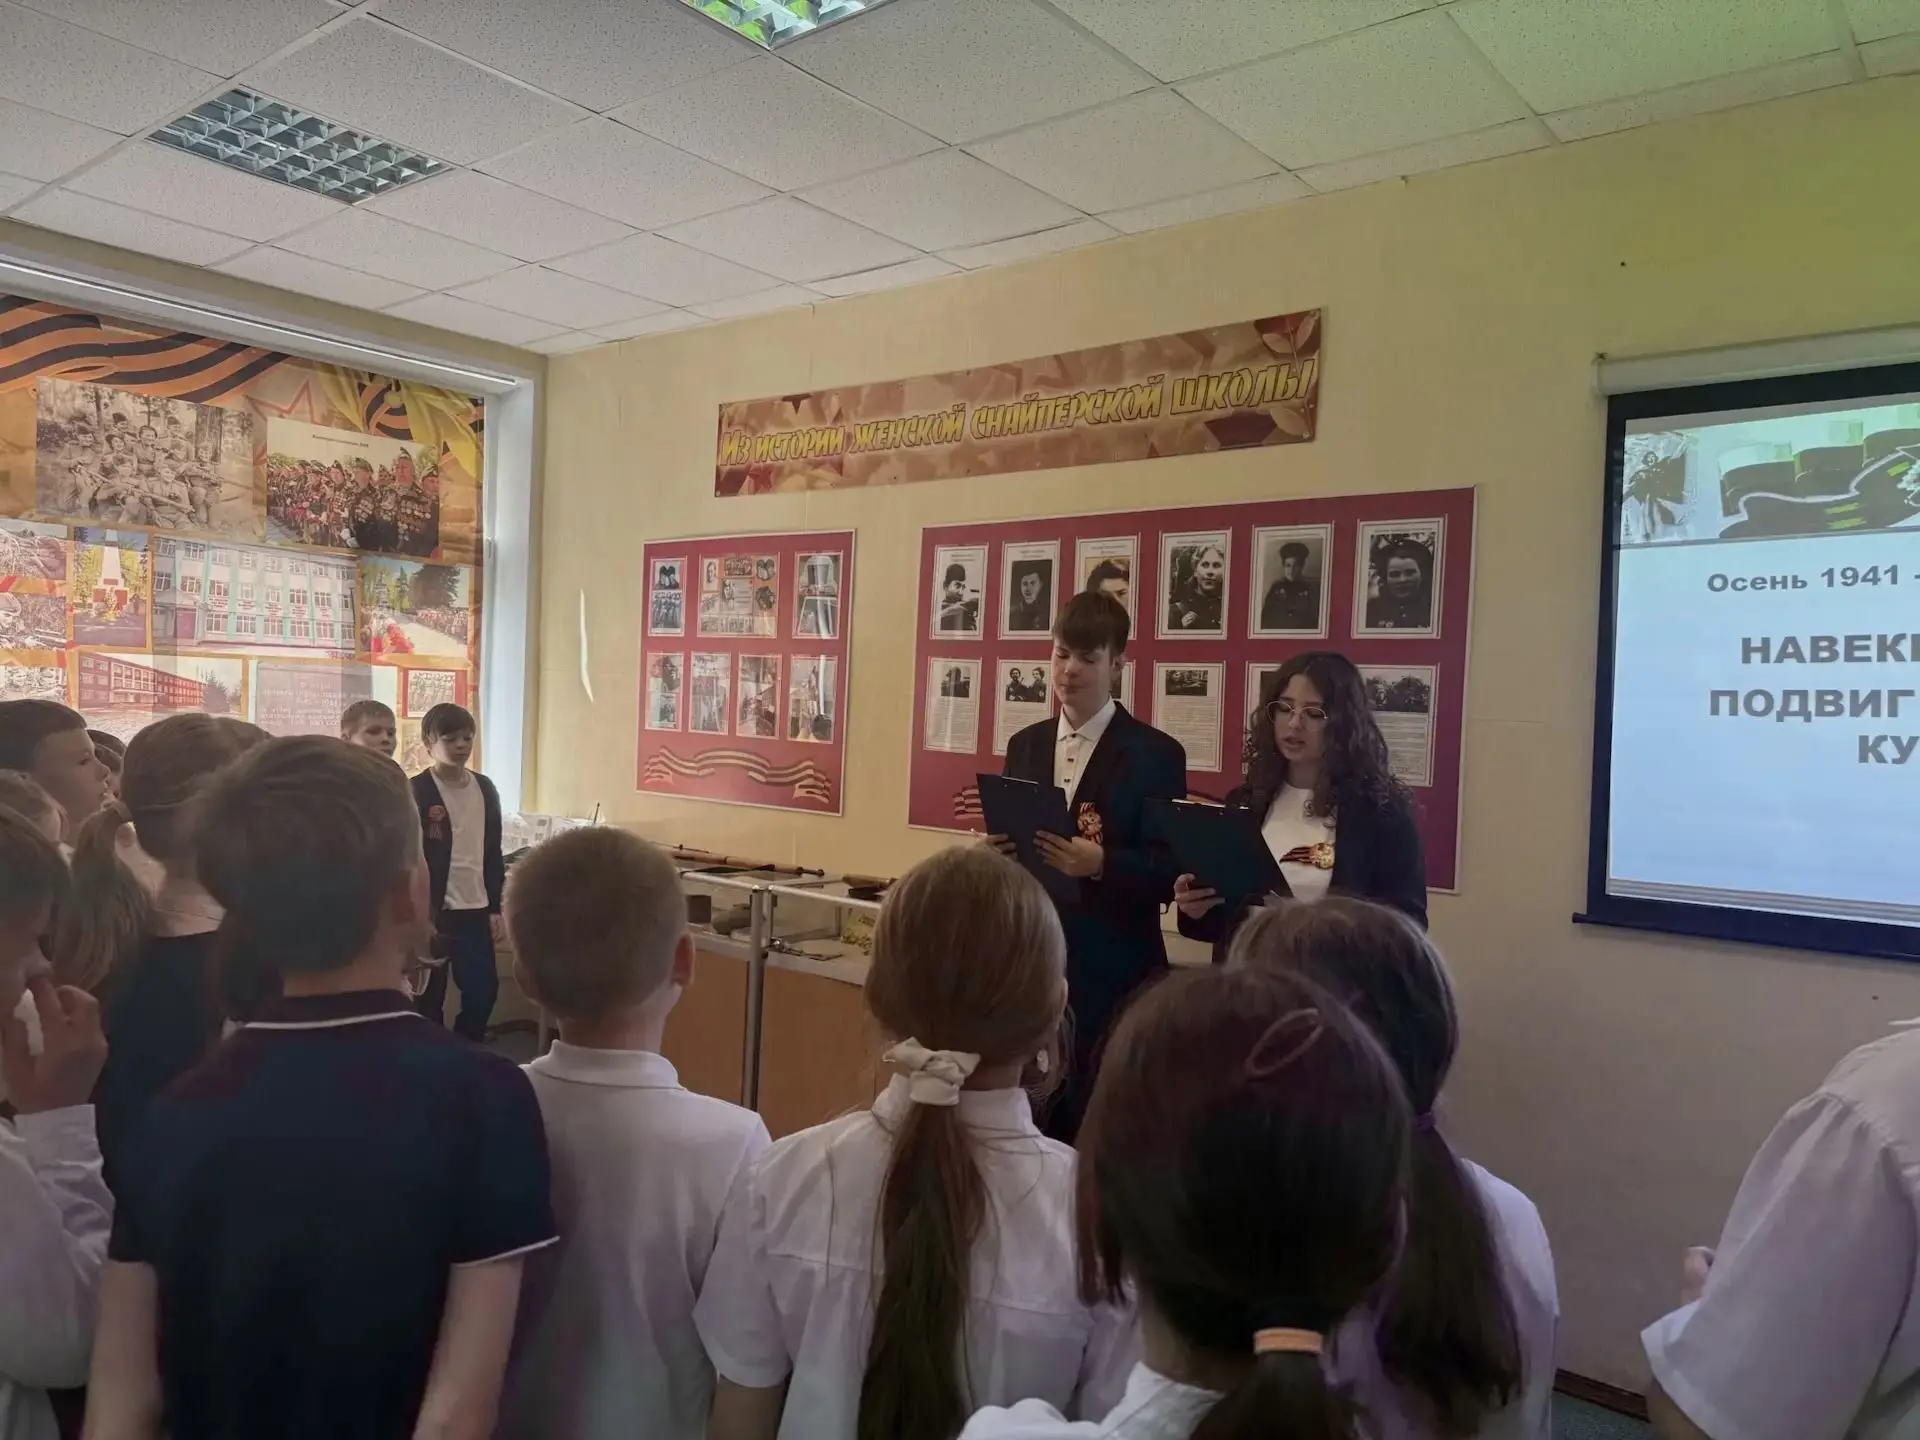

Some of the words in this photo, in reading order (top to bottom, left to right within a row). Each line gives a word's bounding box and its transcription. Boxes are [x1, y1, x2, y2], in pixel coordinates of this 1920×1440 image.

[849, 402, 967, 454] ЖЕНСКОЙ
[970, 373, 1166, 440] СНАЙПЕРСКОЙ
[1169, 358, 1316, 416] ШКОЛЫ
[1707, 573, 1808, 592] Осень
[1820, 564, 1899, 588] 1941
[1741, 633, 1920, 664] НАВЕК
[1710, 689, 1915, 722] ПОДВИГ
